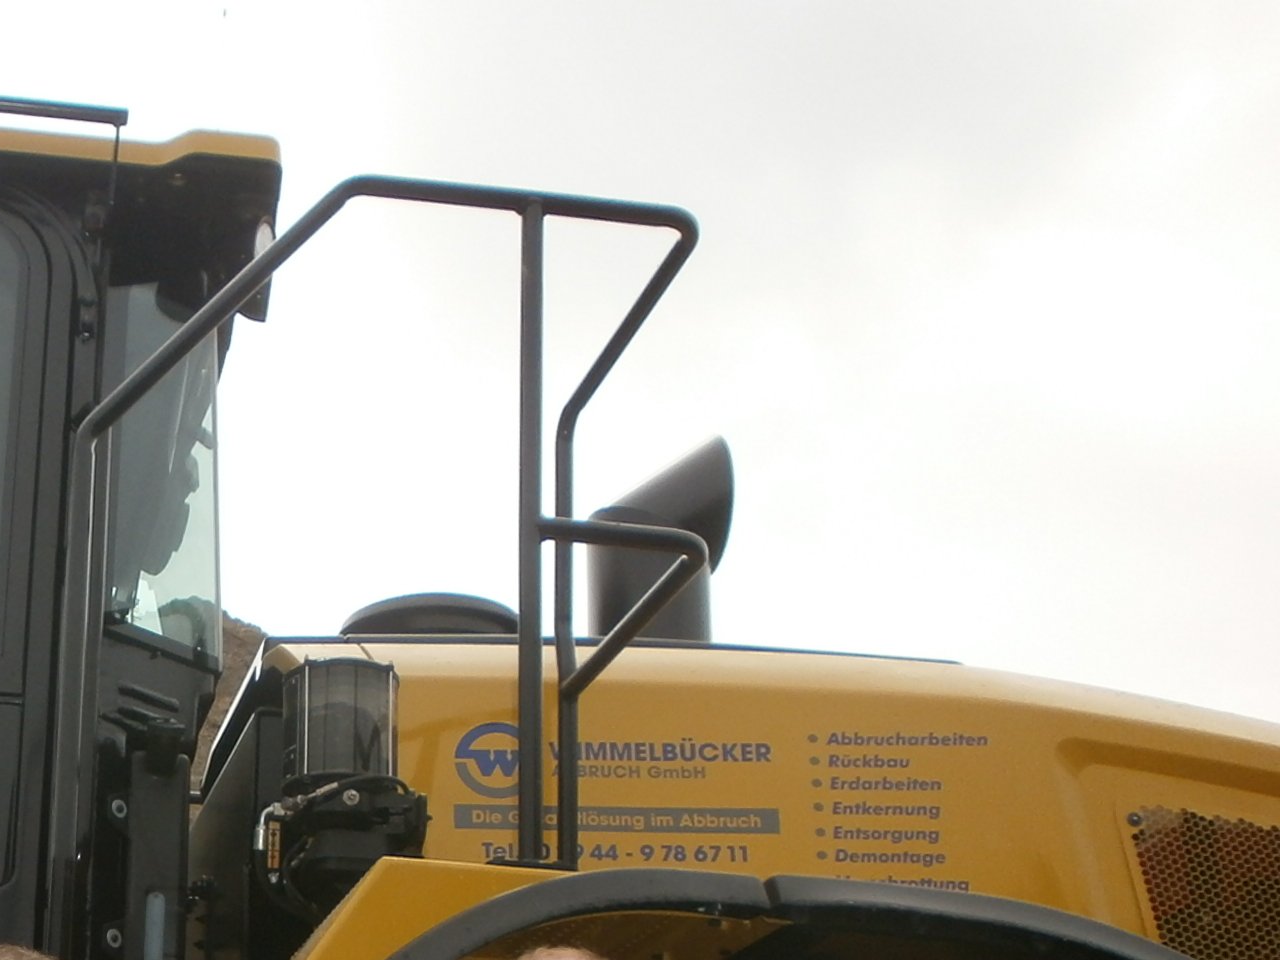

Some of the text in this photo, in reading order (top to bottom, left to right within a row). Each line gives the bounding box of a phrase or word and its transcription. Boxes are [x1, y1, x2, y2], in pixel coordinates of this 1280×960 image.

[827, 733, 988, 746] Abbrucharbeiten
[828, 755, 909, 768] Rückbau
[648, 766, 706, 779] GmbH
[830, 777, 941, 791] Erdarbeiten
[832, 802, 940, 819] Entkernung
[472, 811, 501, 824] Die
[651, 813, 673, 827] im
[680, 814, 761, 828] Abbruch
[833, 826, 939, 843] Entsorgung
[835, 849, 945, 866] Demontage
